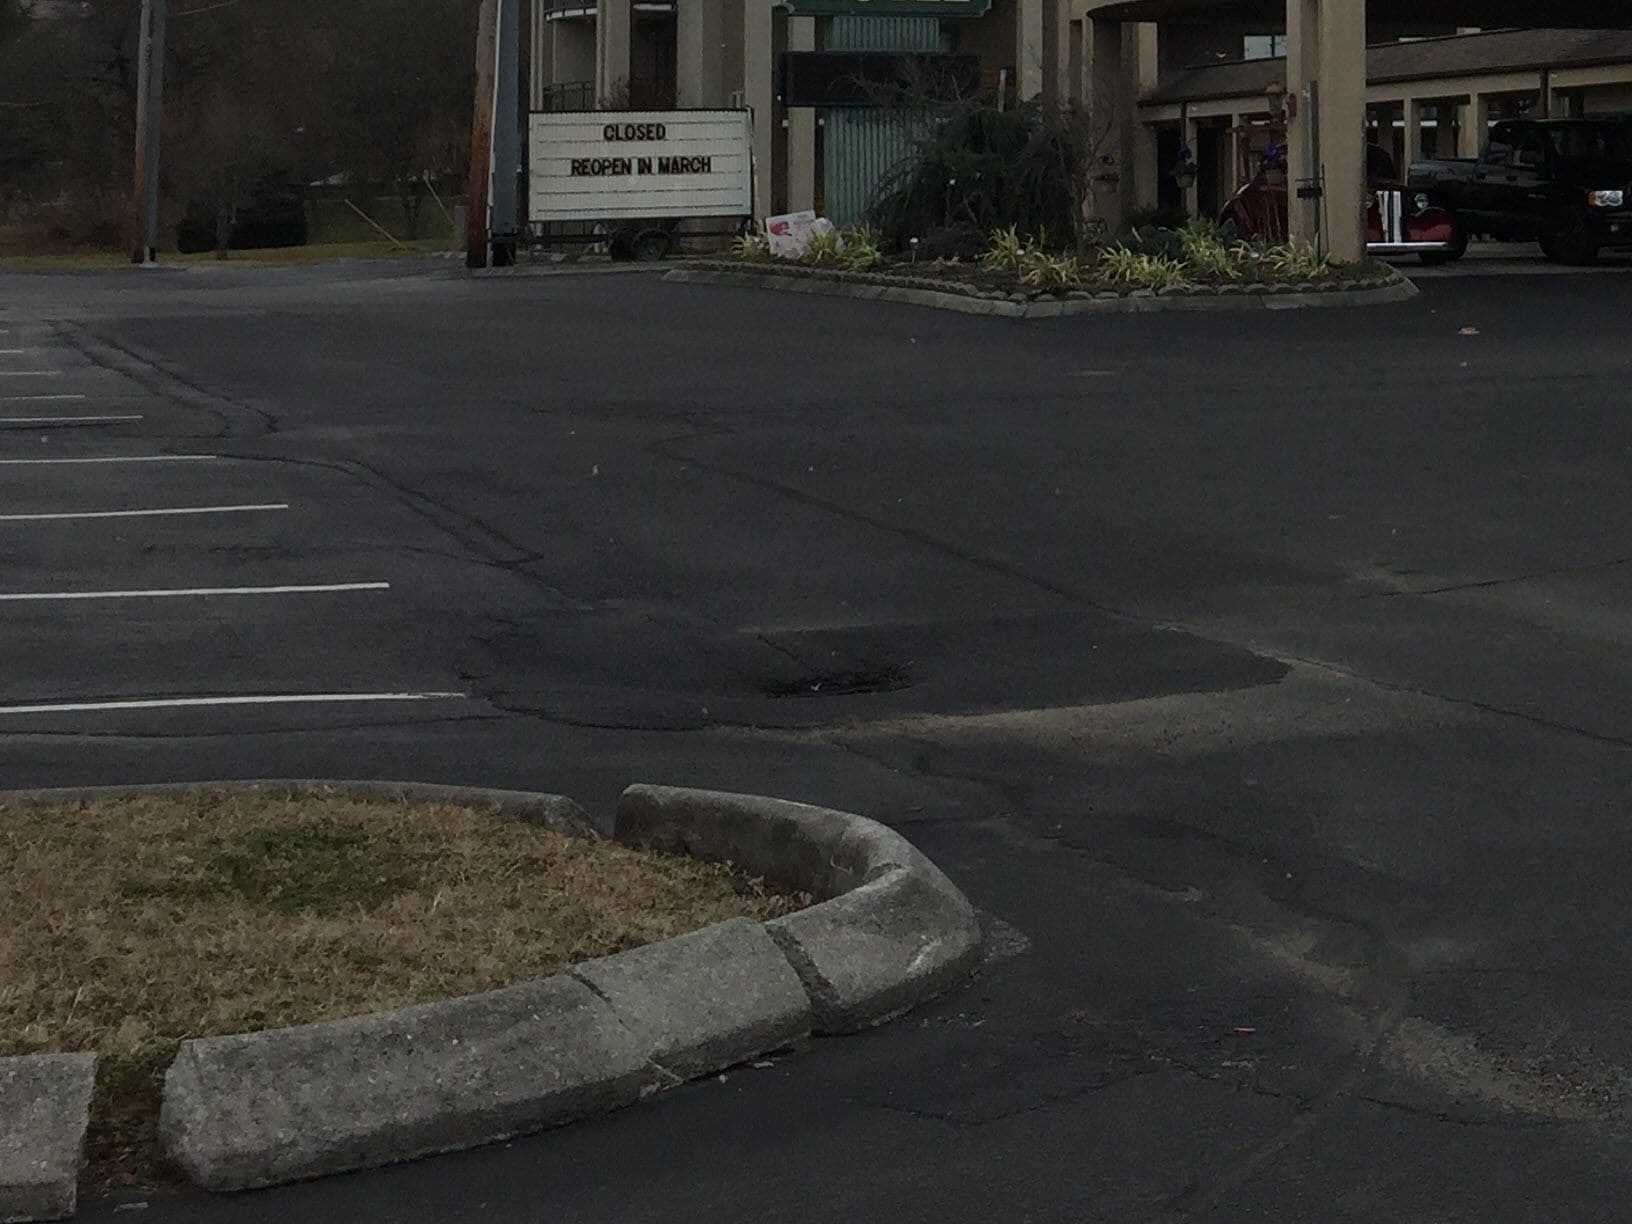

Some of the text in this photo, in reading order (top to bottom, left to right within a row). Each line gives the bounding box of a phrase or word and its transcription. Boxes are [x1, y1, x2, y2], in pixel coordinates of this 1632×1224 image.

[603, 123, 666, 141] CLOSED
[571, 156, 711, 176] REOPEN IN MARCH
